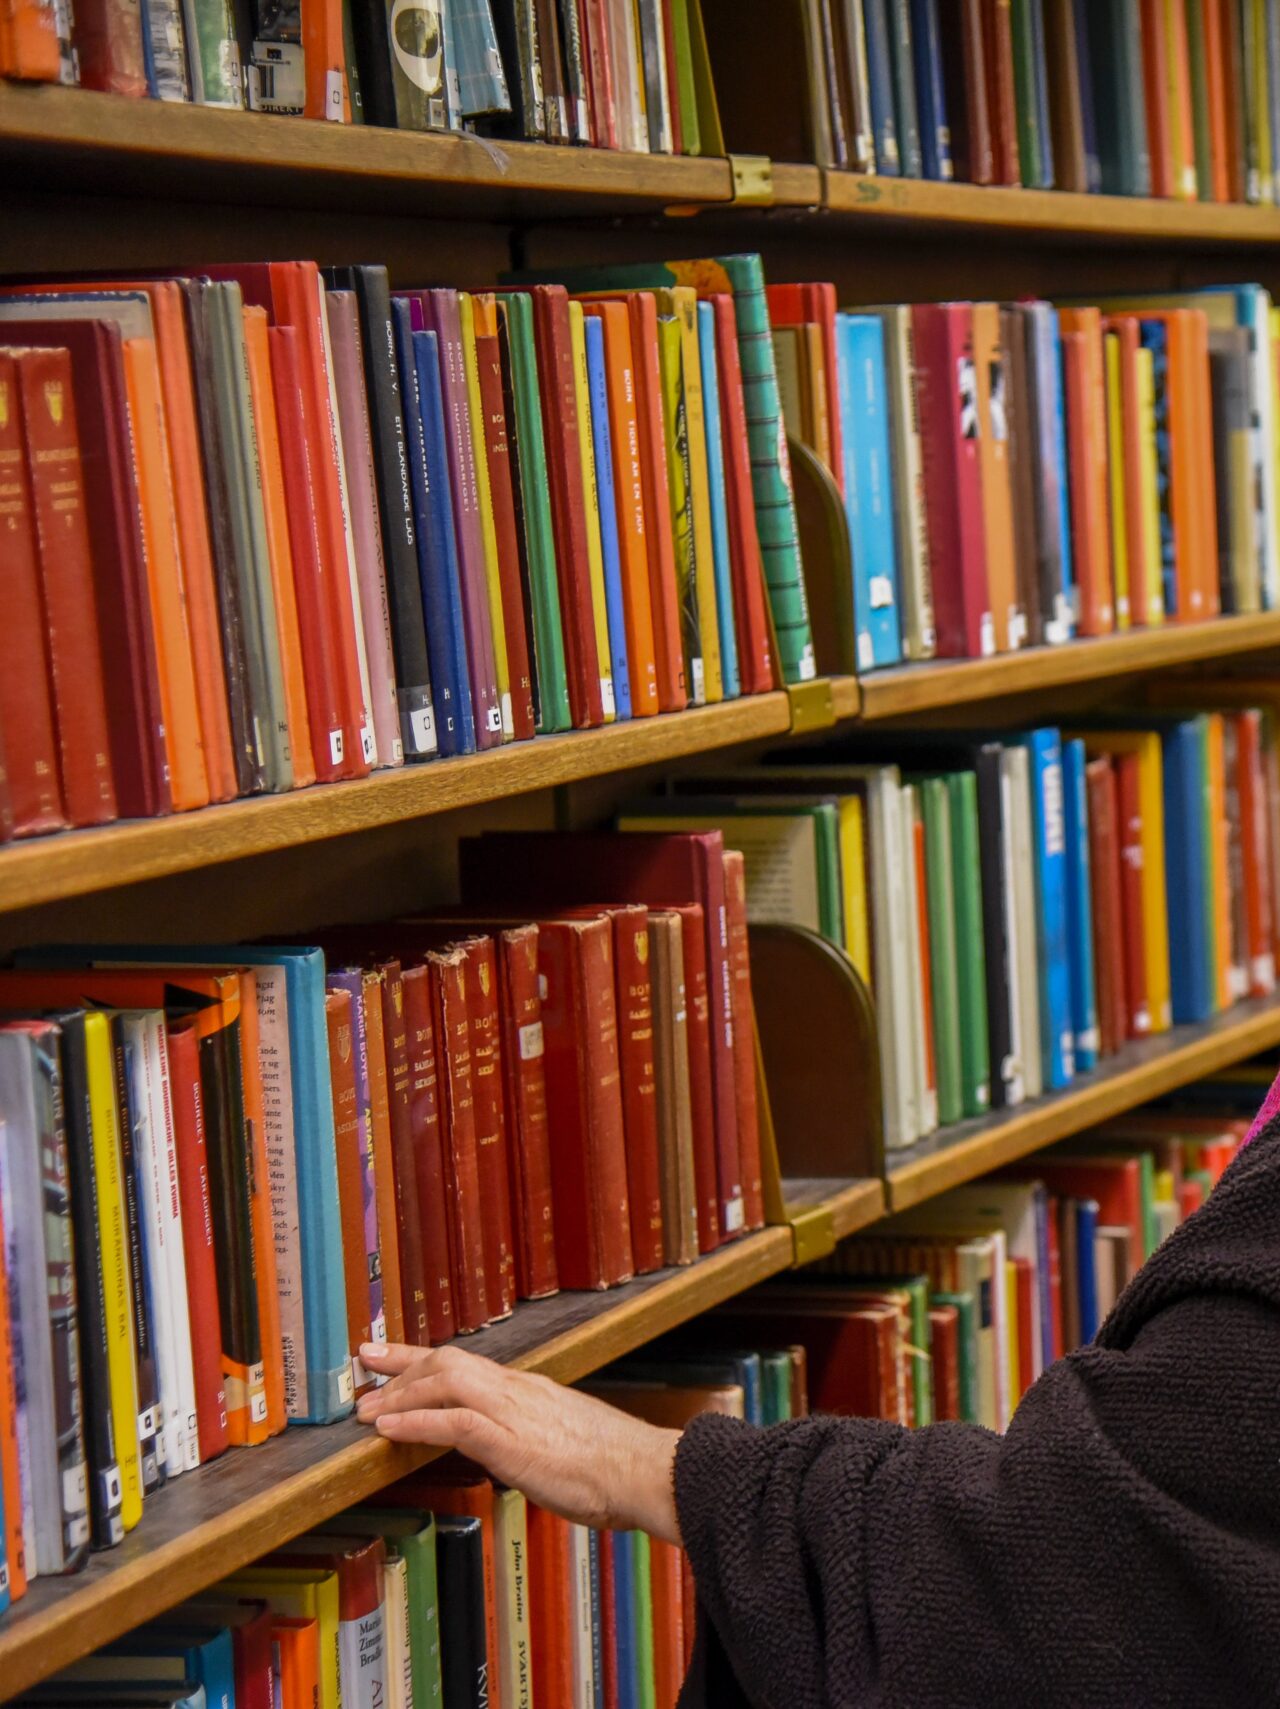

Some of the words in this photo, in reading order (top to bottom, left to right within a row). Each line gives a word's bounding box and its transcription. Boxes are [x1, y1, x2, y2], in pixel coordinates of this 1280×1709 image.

[624, 368, 633, 403] BORN
[405, 518, 413, 545] LJUS
[356, 994, 366, 1039] KARIN
[360, 1041, 368, 1081] BOYE
[193, 1081, 204, 1145] BOURGET
[364, 1107, 376, 1171] ASTARTE
[512, 1539, 522, 1571] John
[515, 1575, 524, 1623] Braine
